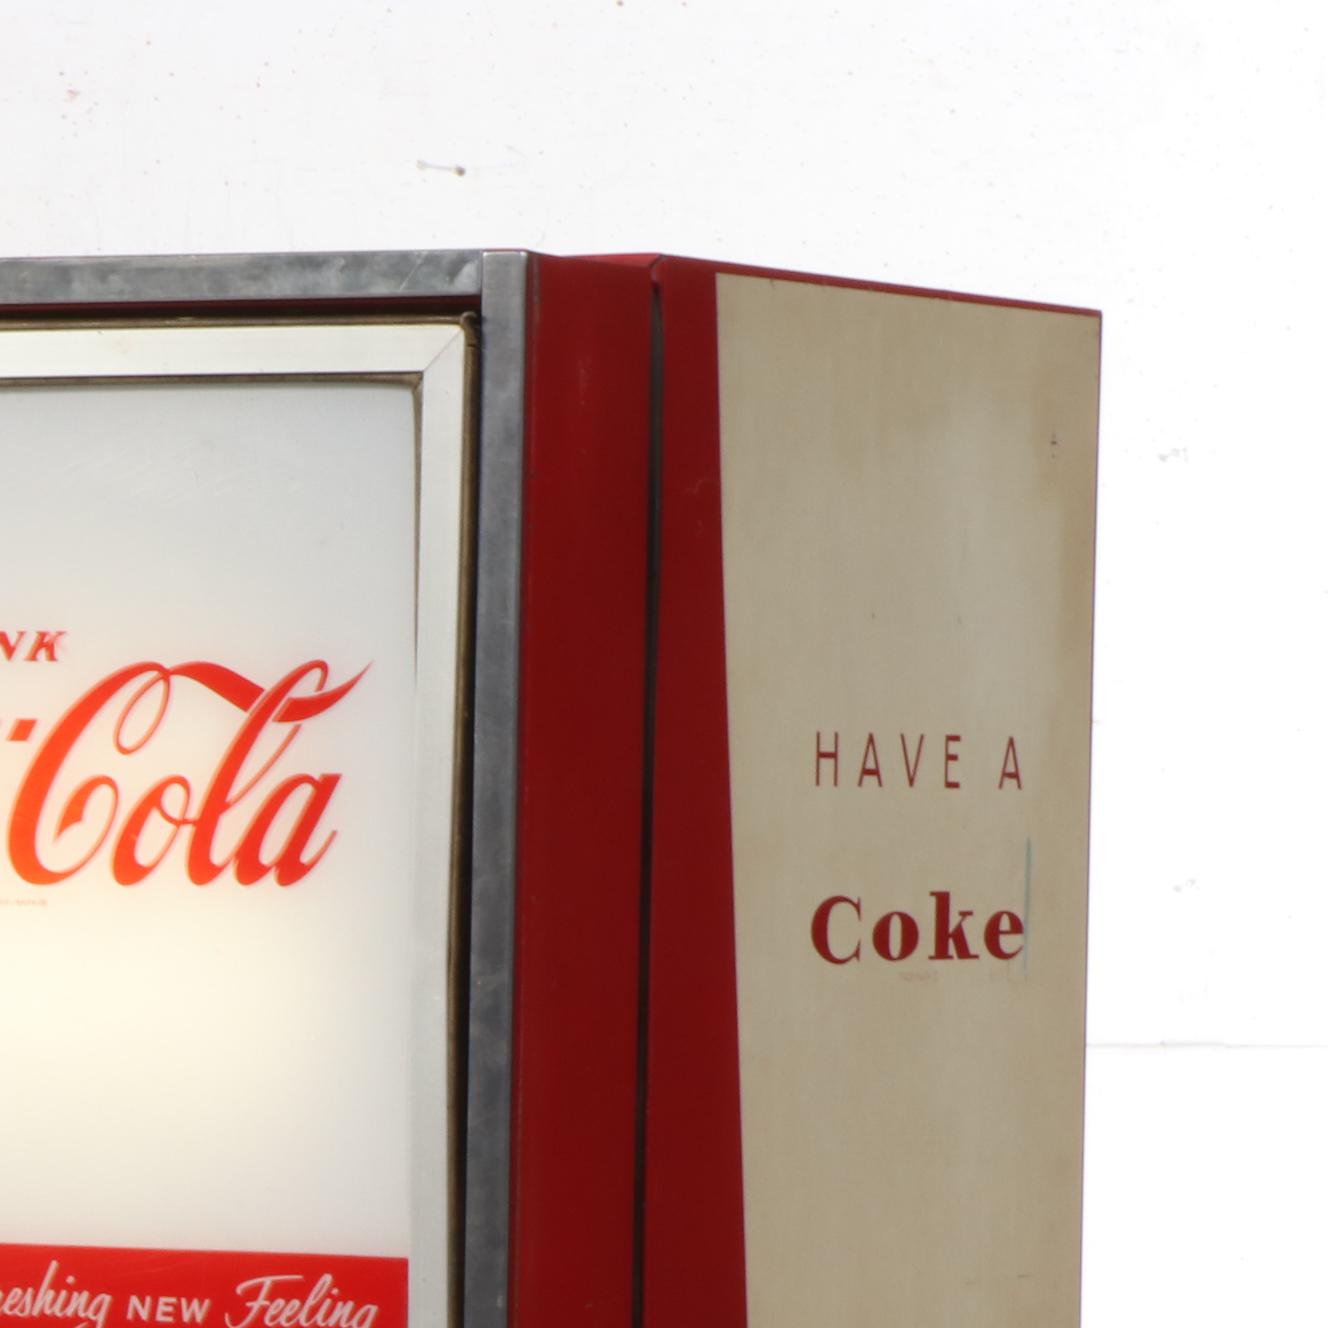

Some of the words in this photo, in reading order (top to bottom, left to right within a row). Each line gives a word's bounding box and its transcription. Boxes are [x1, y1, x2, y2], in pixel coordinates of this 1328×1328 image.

[815, 731, 961, 789] HAVE
[998, 736, 1023, 791] A
[811, 891, 1025, 965] Coke
[127, 1295, 211, 1324] NEW
